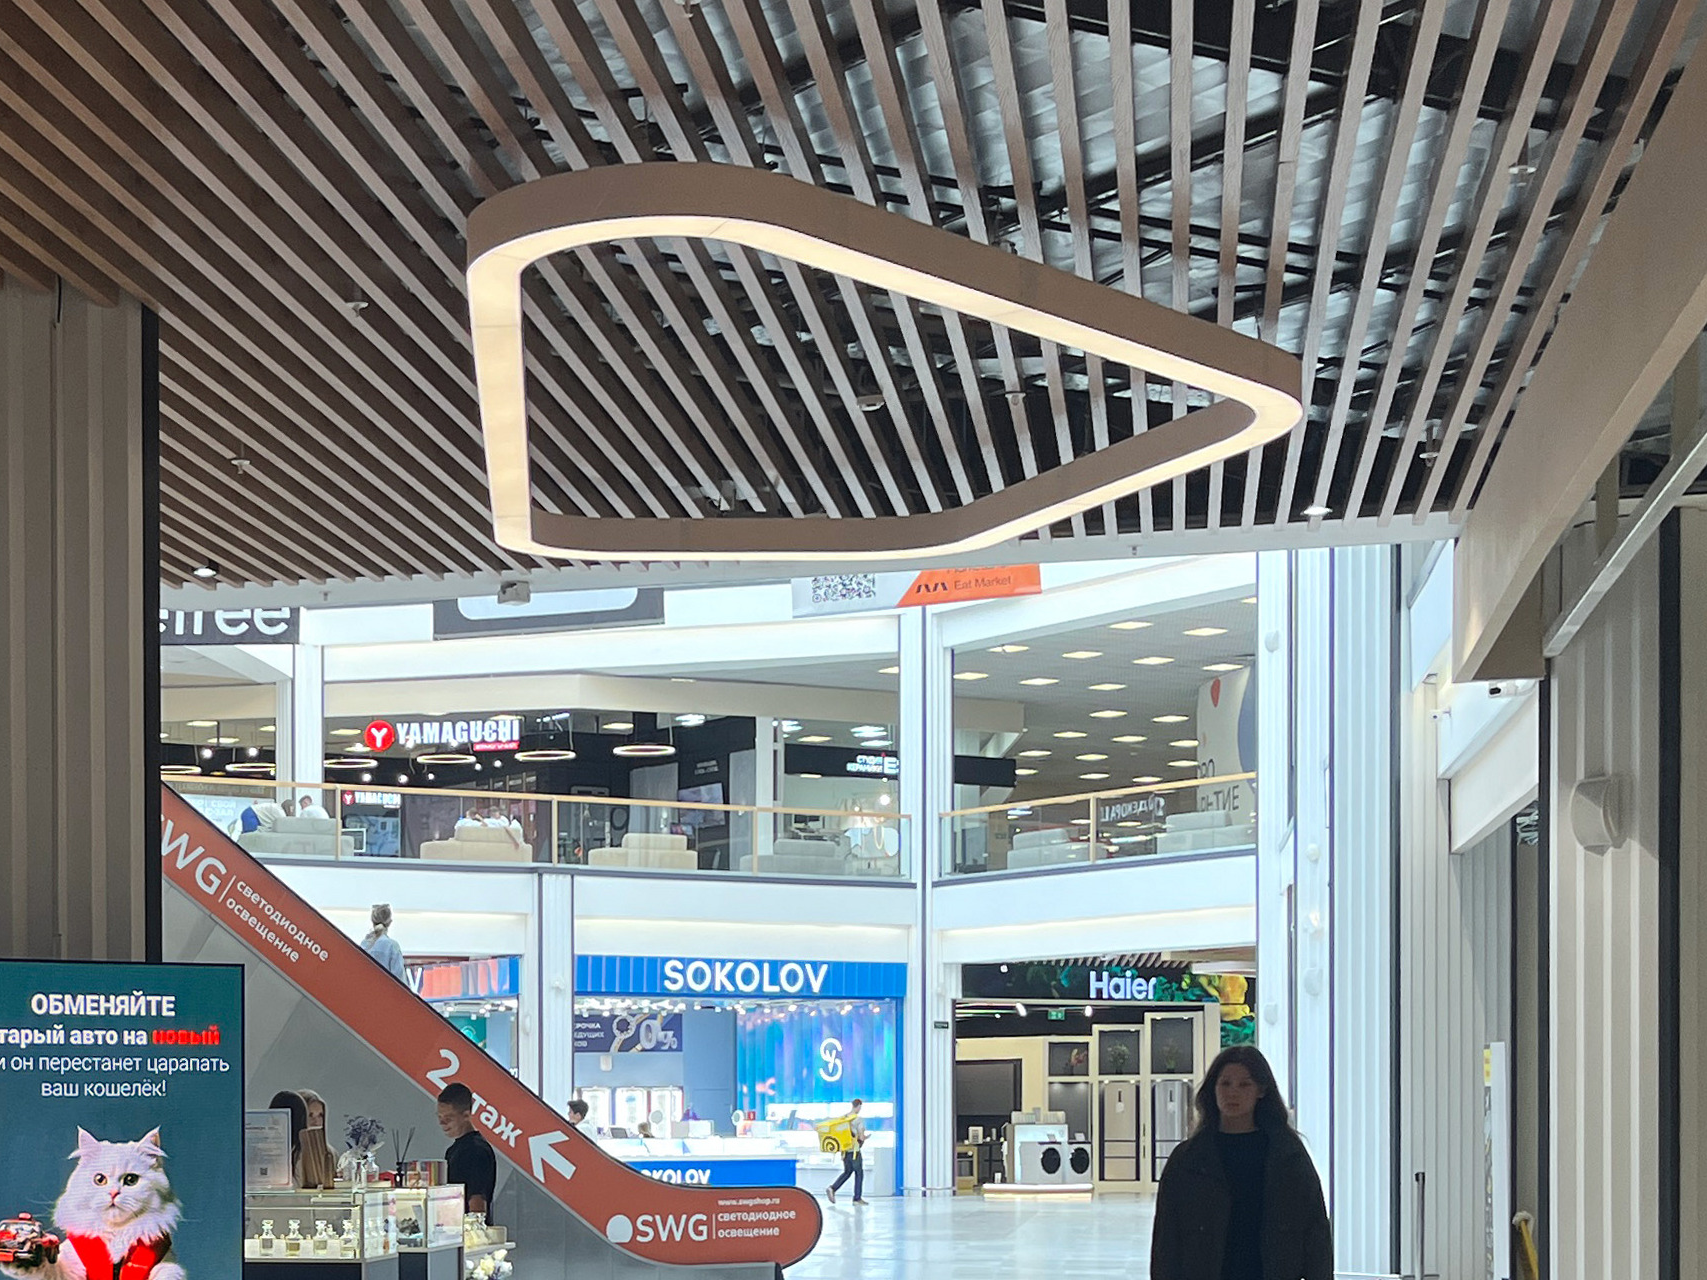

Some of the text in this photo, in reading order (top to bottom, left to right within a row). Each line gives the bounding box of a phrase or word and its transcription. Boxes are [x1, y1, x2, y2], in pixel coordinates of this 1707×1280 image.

[161, 815, 227, 896] WG
[226, 897, 300, 962] освещение
[237, 881, 329, 962] светодиодное
[664, 959, 829, 994] SOKOLOV
[1089, 971, 1159, 999] Haier
[30, 990, 176, 1017] ОБМЕНЯЙТЕ
[69, 1029, 118, 1046] авто
[123, 1029, 148, 1046] на
[152, 1025, 221, 1046] новый
[11, 1058, 34, 1071] он
[38, 1057, 143, 1075] перестанет
[147, 1058, 230, 1075] царапать
[41, 1078, 167, 1097] ваш кошелёк!
[426, 1048, 523, 1148] 2 таж
[636, 1213, 708, 1243] SWG
[718, 1209, 796, 1222] светодиодное
[718, 1227, 780, 1238] освещение
